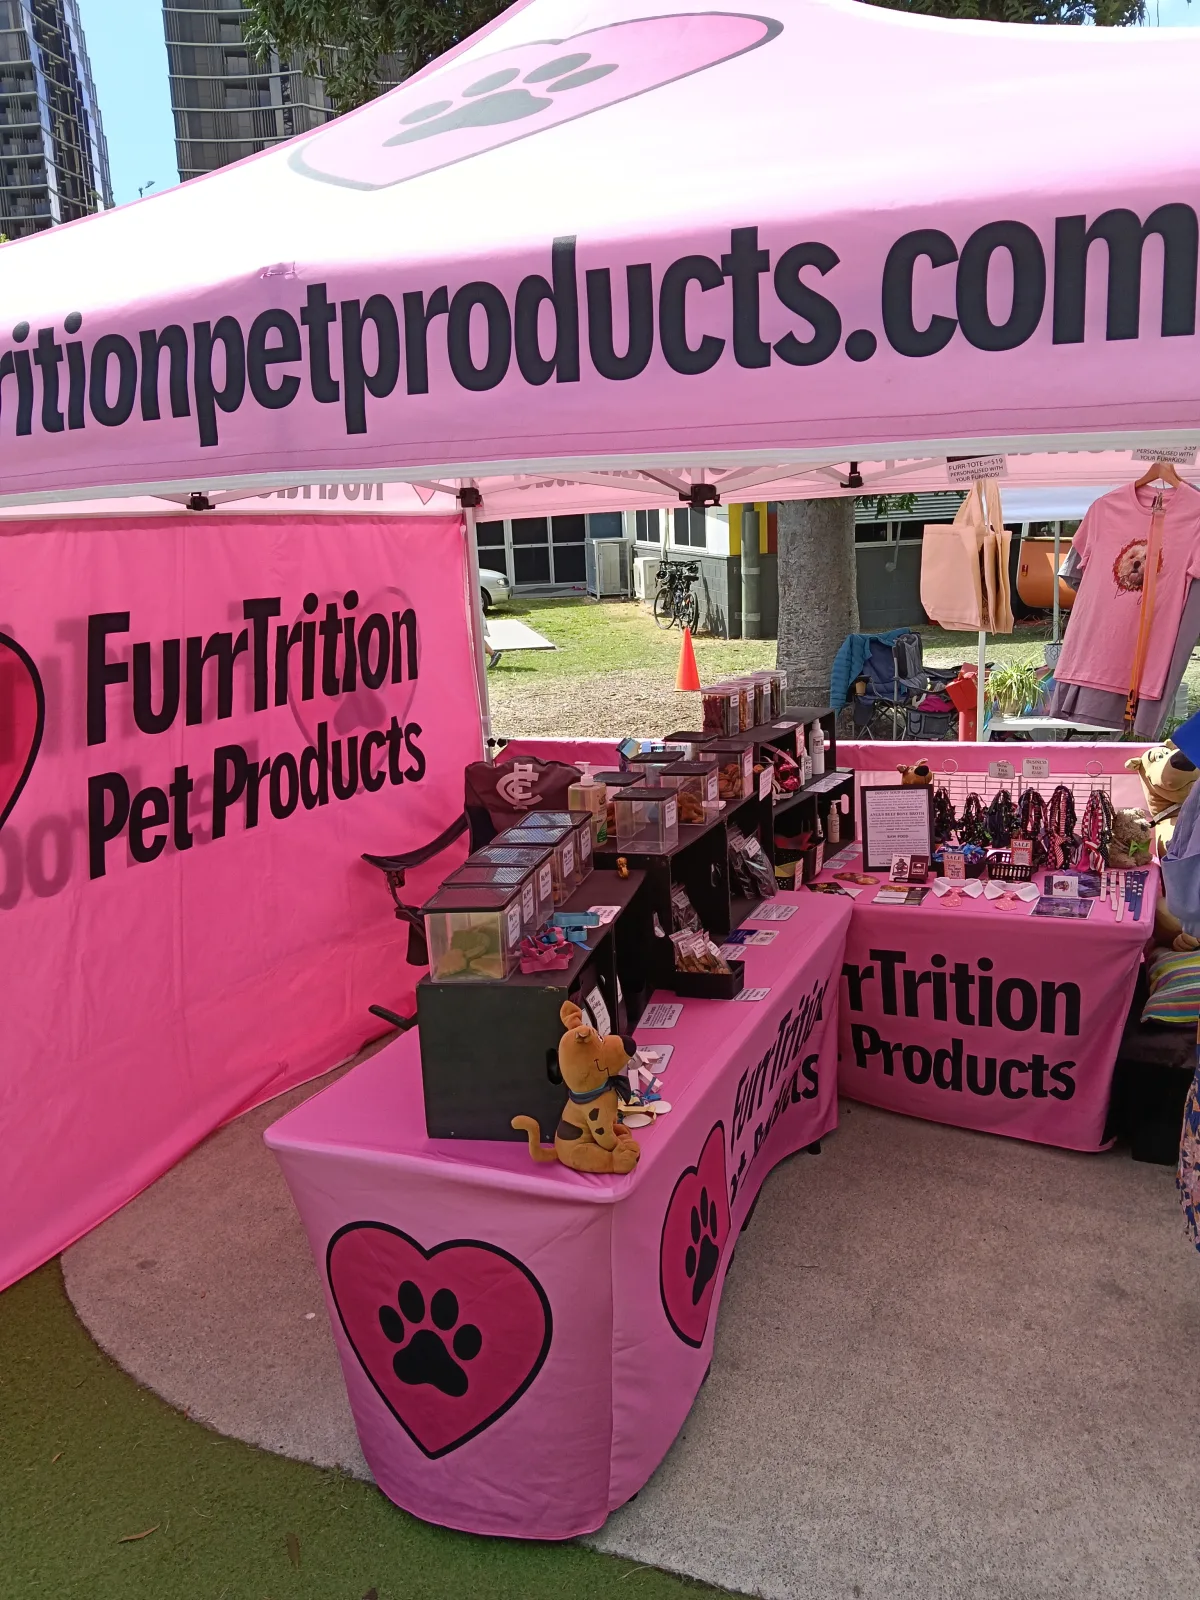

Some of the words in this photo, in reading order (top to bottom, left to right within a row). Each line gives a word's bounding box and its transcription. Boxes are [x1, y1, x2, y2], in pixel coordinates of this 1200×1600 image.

[950, 467, 989, 477] PERSONALISED
[1136, 449, 1178, 457] PERSONALISED
[87, 589, 418, 747] FurrTrition
[88, 765, 195, 880] Pet
[212, 716, 426, 840] Products
[841, 948, 1081, 1036] rTrition
[851, 1023, 1076, 1101] Products
